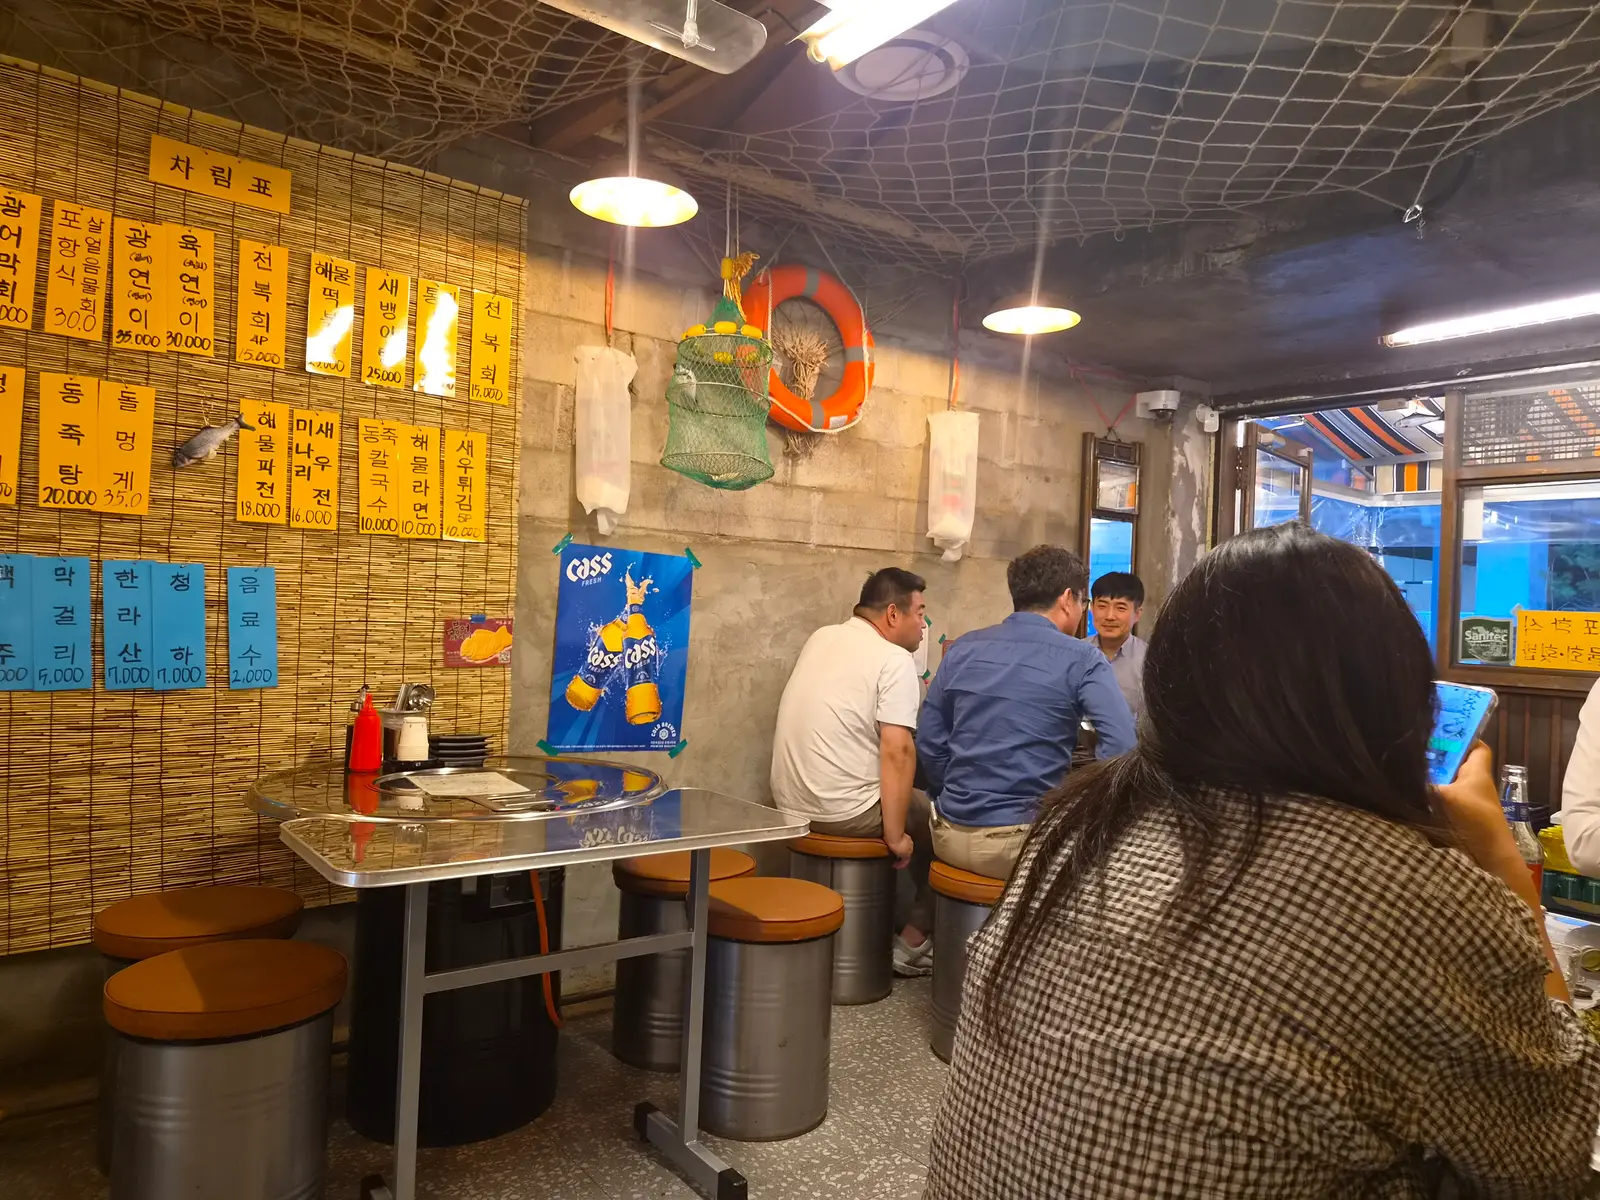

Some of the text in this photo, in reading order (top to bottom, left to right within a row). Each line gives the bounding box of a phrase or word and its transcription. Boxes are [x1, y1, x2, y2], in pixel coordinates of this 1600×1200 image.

[170, 155, 273, 198] 차림표
[55, 208, 82, 286] 포항식
[250, 250, 273, 333] 전복회
[481, 300, 501, 385] 전복회
[58, 382, 85, 485] 동죽탕
[112, 390, 140, 491] 돌멍게
[255, 411, 277, 499] 해물파전
[410, 433, 429, 520] 해물라면
[455, 439, 475, 512] 새우튀김
[52, 566, 77, 665] 막걸리
[113, 568, 143, 664] 한라산
[169, 571, 194, 665] 청하
[238, 576, 262, 667] 음료수
[581, 577, 602, 587] FRESH
[651, 722, 677, 737] COLD BREWED
